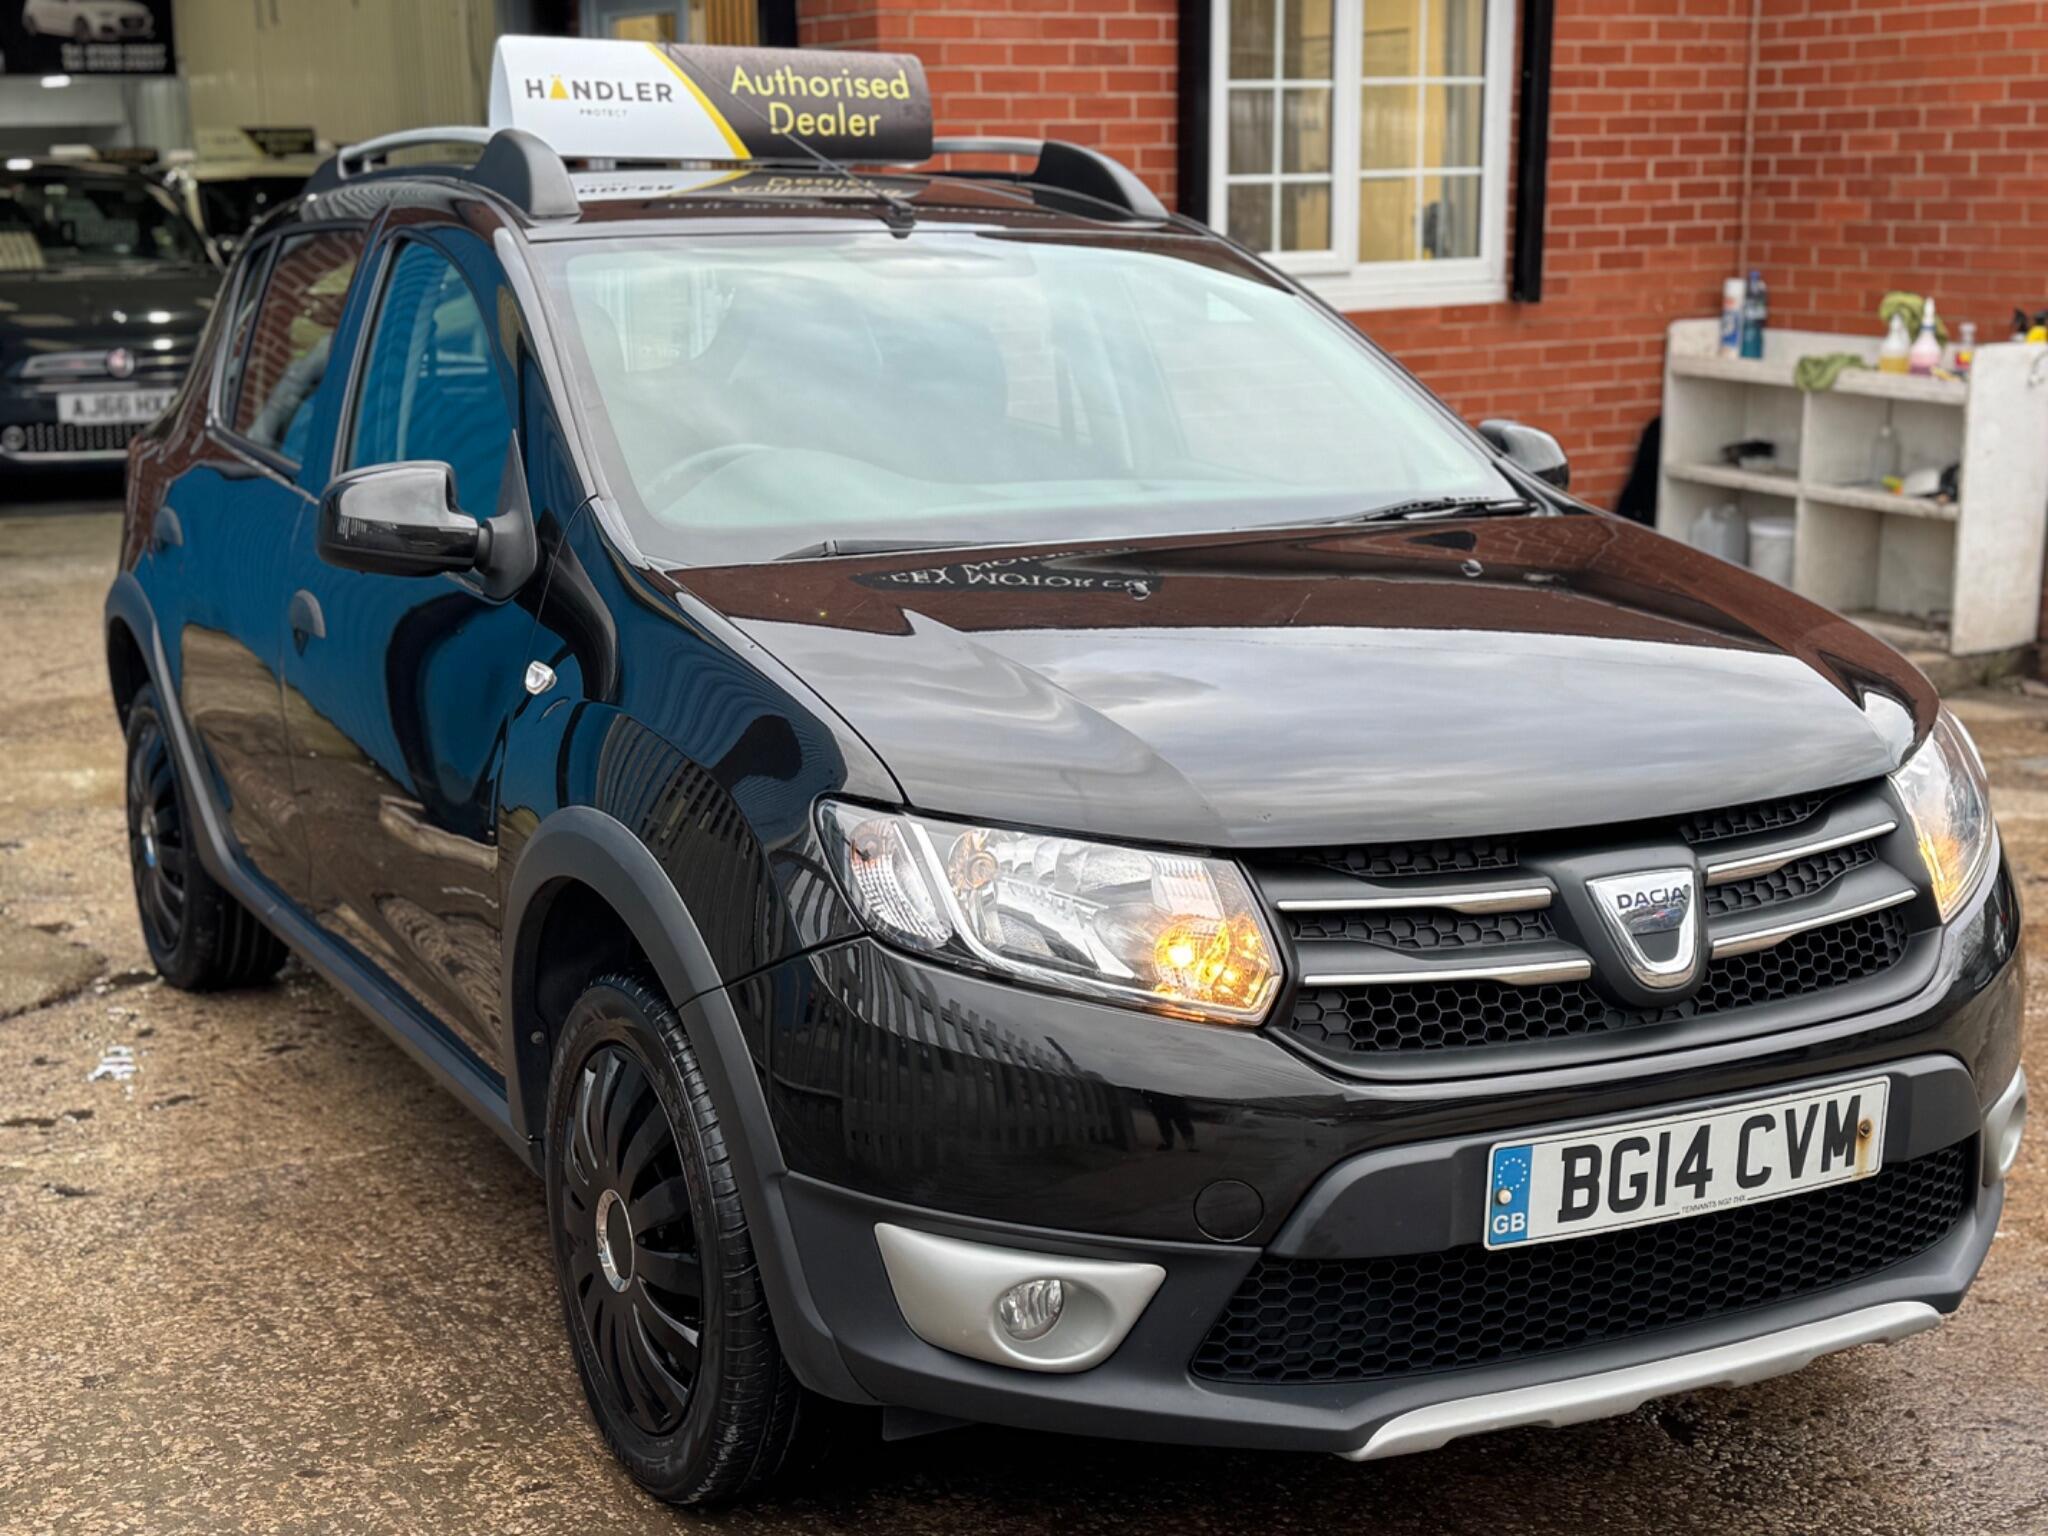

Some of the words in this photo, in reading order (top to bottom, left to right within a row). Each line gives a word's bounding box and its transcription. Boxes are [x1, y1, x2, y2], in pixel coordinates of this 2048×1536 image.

[730, 65, 912, 101] Authorised
[579, 108, 628, 118] PROTECT
[769, 101, 881, 138] Dealer
[1616, 886, 1687, 910] DACIA
[1557, 1124, 1713, 1223] BG14
[1735, 1095, 1862, 1189] CVM
[1492, 1212, 1526, 1236] GB
